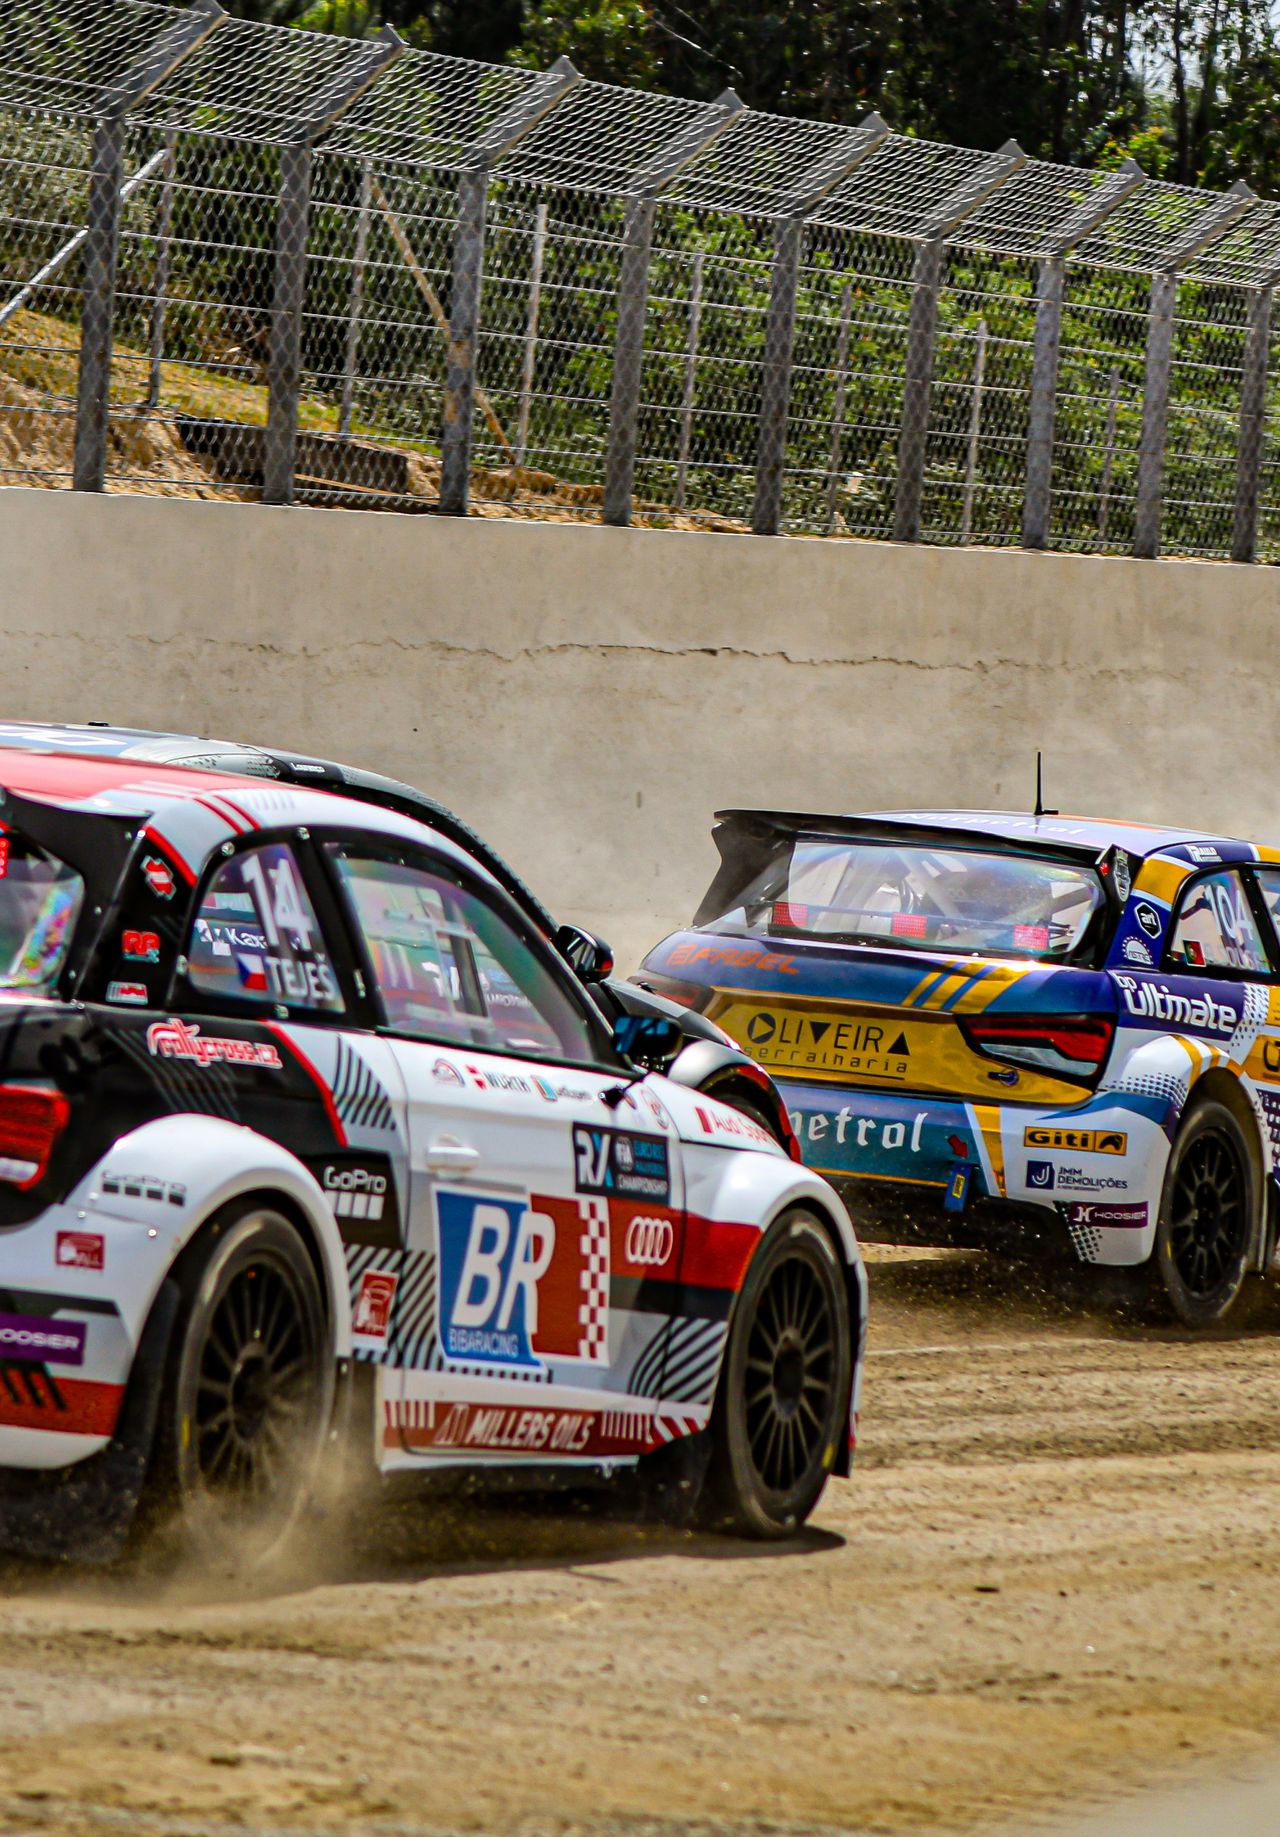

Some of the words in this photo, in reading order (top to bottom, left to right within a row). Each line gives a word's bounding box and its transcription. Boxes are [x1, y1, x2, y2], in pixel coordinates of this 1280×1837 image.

[241, 853, 313, 950] 14
[1204, 885, 1253, 940] 104
[747, 1013, 910, 1056] OLIVEIRA
[745, 1046, 908, 1073] serralharia
[1028, 1131, 1089, 1148] Giti
[575, 1129, 614, 1188] RX
[1059, 1167, 1082, 1176] JMM
[324, 1166, 386, 1194] GoPro
[1058, 1175, 1128, 1190] DEMOLIÇÕES
[1095, 1211, 1146, 1220] HOOSIER
[451, 1204, 555, 1334] BR
[448, 1328, 519, 1358] BIBARACING
[466, 1409, 554, 1448] MILLERS
[551, 1414, 595, 1451] OILS
